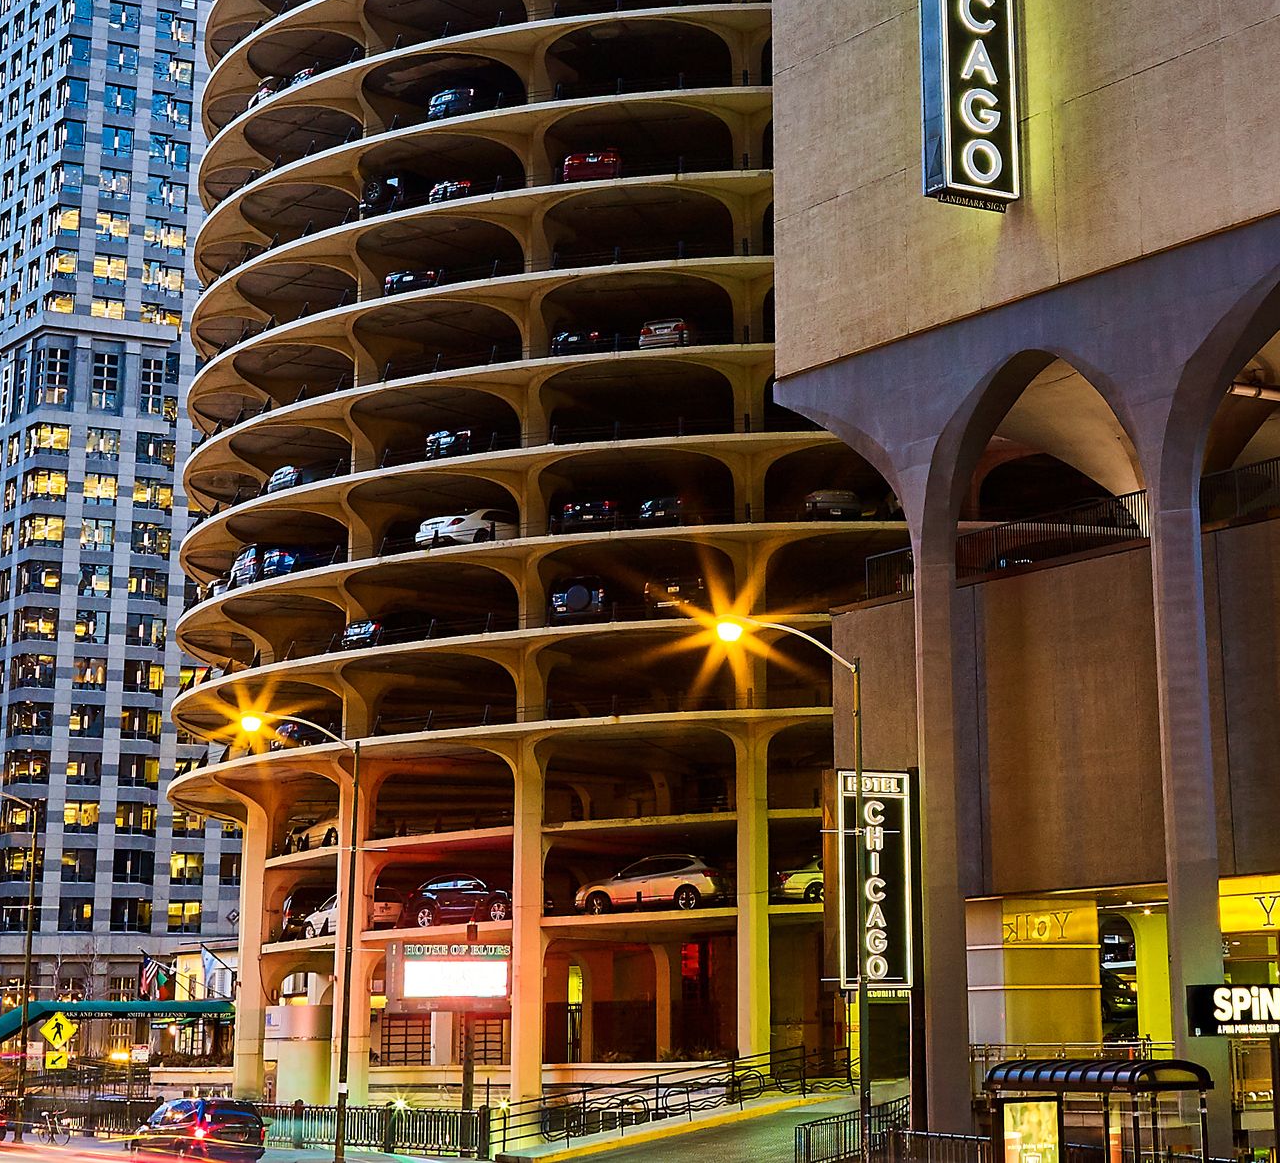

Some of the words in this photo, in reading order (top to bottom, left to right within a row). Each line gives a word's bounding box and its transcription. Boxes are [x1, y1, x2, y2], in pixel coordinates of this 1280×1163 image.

[939, 193, 985, 209] LANDMARK
[986, 201, 1006, 212] SIGN
[847, 776, 901, 794] HOTEL
[864, 800, 889, 980] CHICAGO
[404, 944, 448, 956] HOUSE
[450, 944, 469, 955] OF
[470, 944, 511, 956] BLUES
